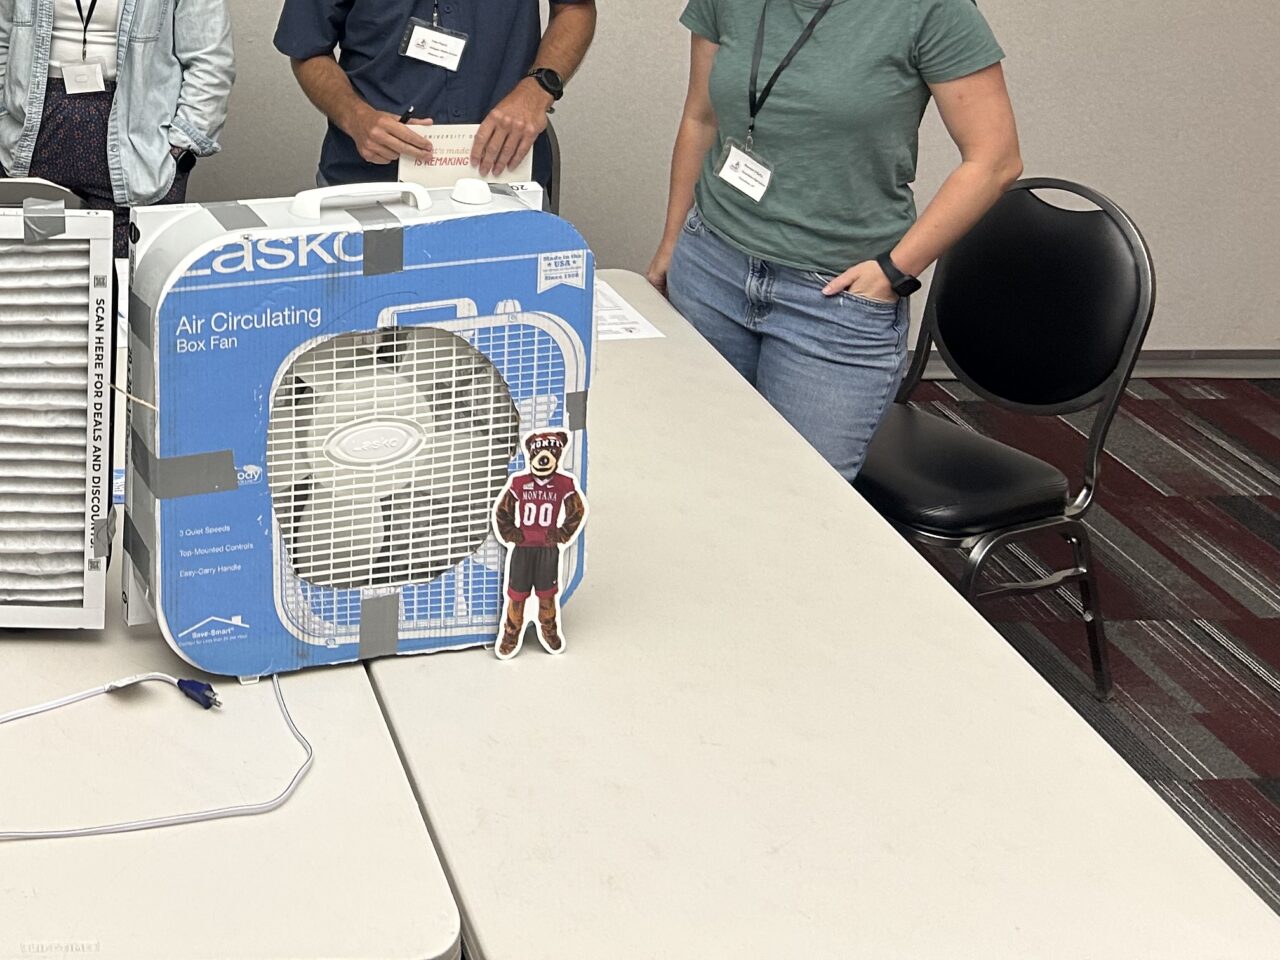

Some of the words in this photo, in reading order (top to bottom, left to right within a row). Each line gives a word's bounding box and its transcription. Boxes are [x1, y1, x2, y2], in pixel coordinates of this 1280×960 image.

[95, 298, 105, 332] SCAN
[176, 315, 206, 336] Air
[210, 305, 321, 331] Circulating
[94, 336, 104, 369] HERE
[176, 339, 206, 353] Box
[210, 335, 238, 350] Fan
[94, 373, 103, 398] FOR
[93, 402, 103, 442] DEALS
[92, 445, 102, 472] AND
[522, 490, 557, 501] MONTANA
[523, 502, 554, 527] 00
[185, 528, 203, 536] Quiet
[205, 525, 231, 536] Speeds
[179, 545, 224, 557] Top-Mounted
[225, 542, 254, 552] Controls
[179, 567, 216, 578] Easy-Carry
[217, 563, 242, 573] Handle
